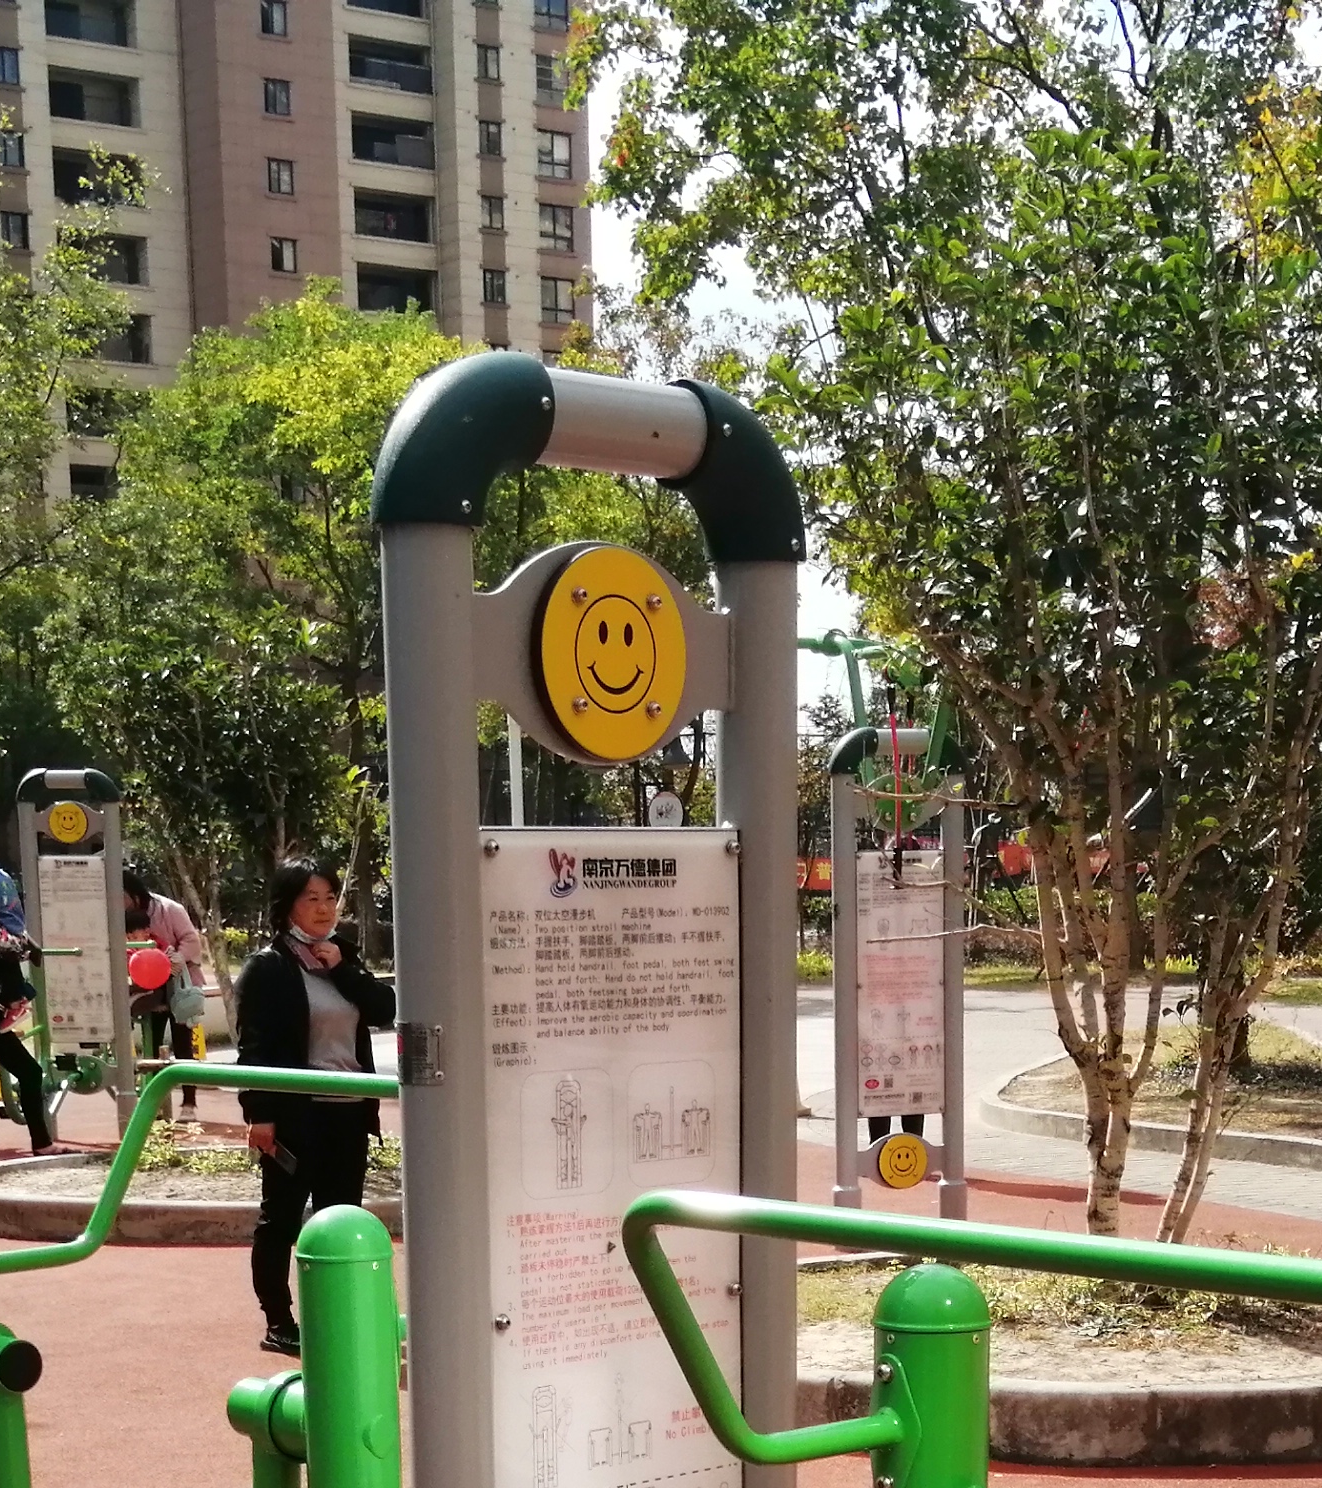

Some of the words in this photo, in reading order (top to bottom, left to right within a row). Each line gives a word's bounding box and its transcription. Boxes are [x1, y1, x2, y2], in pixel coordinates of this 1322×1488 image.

[582, 858, 677, 877] 南京万德集团
[534, 923, 548, 934] Two
[552, 922, 587, 933] position
[534, 962, 554, 973] Hand
[557, 961, 575, 972] hold
[622, 959, 638, 969] foot
[672, 957, 690, 967] both
[693, 956, 709, 966] feet
[713, 956, 734, 967] swing
[535, 976, 553, 986] back
[557, 975, 571, 985] and
[605, 973, 622, 984] Hand
[626, 973, 635, 983] do
[639, 972, 651, 982] not
[655, 971, 673, 982] hold
[718, 967, 734, 978] foot
[566, 987, 584, 998] both
[652, 984, 664, 994] and
[536, 1013, 567, 1025] Improve
[571, 1013, 585, 1024] the
[536, 1028, 550, 1038] and
[553, 1026, 585, 1037] balance
[589, 1024, 619, 1035] ability
[623, 1024, 631, 1033] of
[635, 1023, 648, 1033] the
[589, 1230, 601, 1241] the
[547, 1269, 585, 1282] forbidden
[590, 1267, 598, 1276] to
[665, 1428, 676, 1440] No
